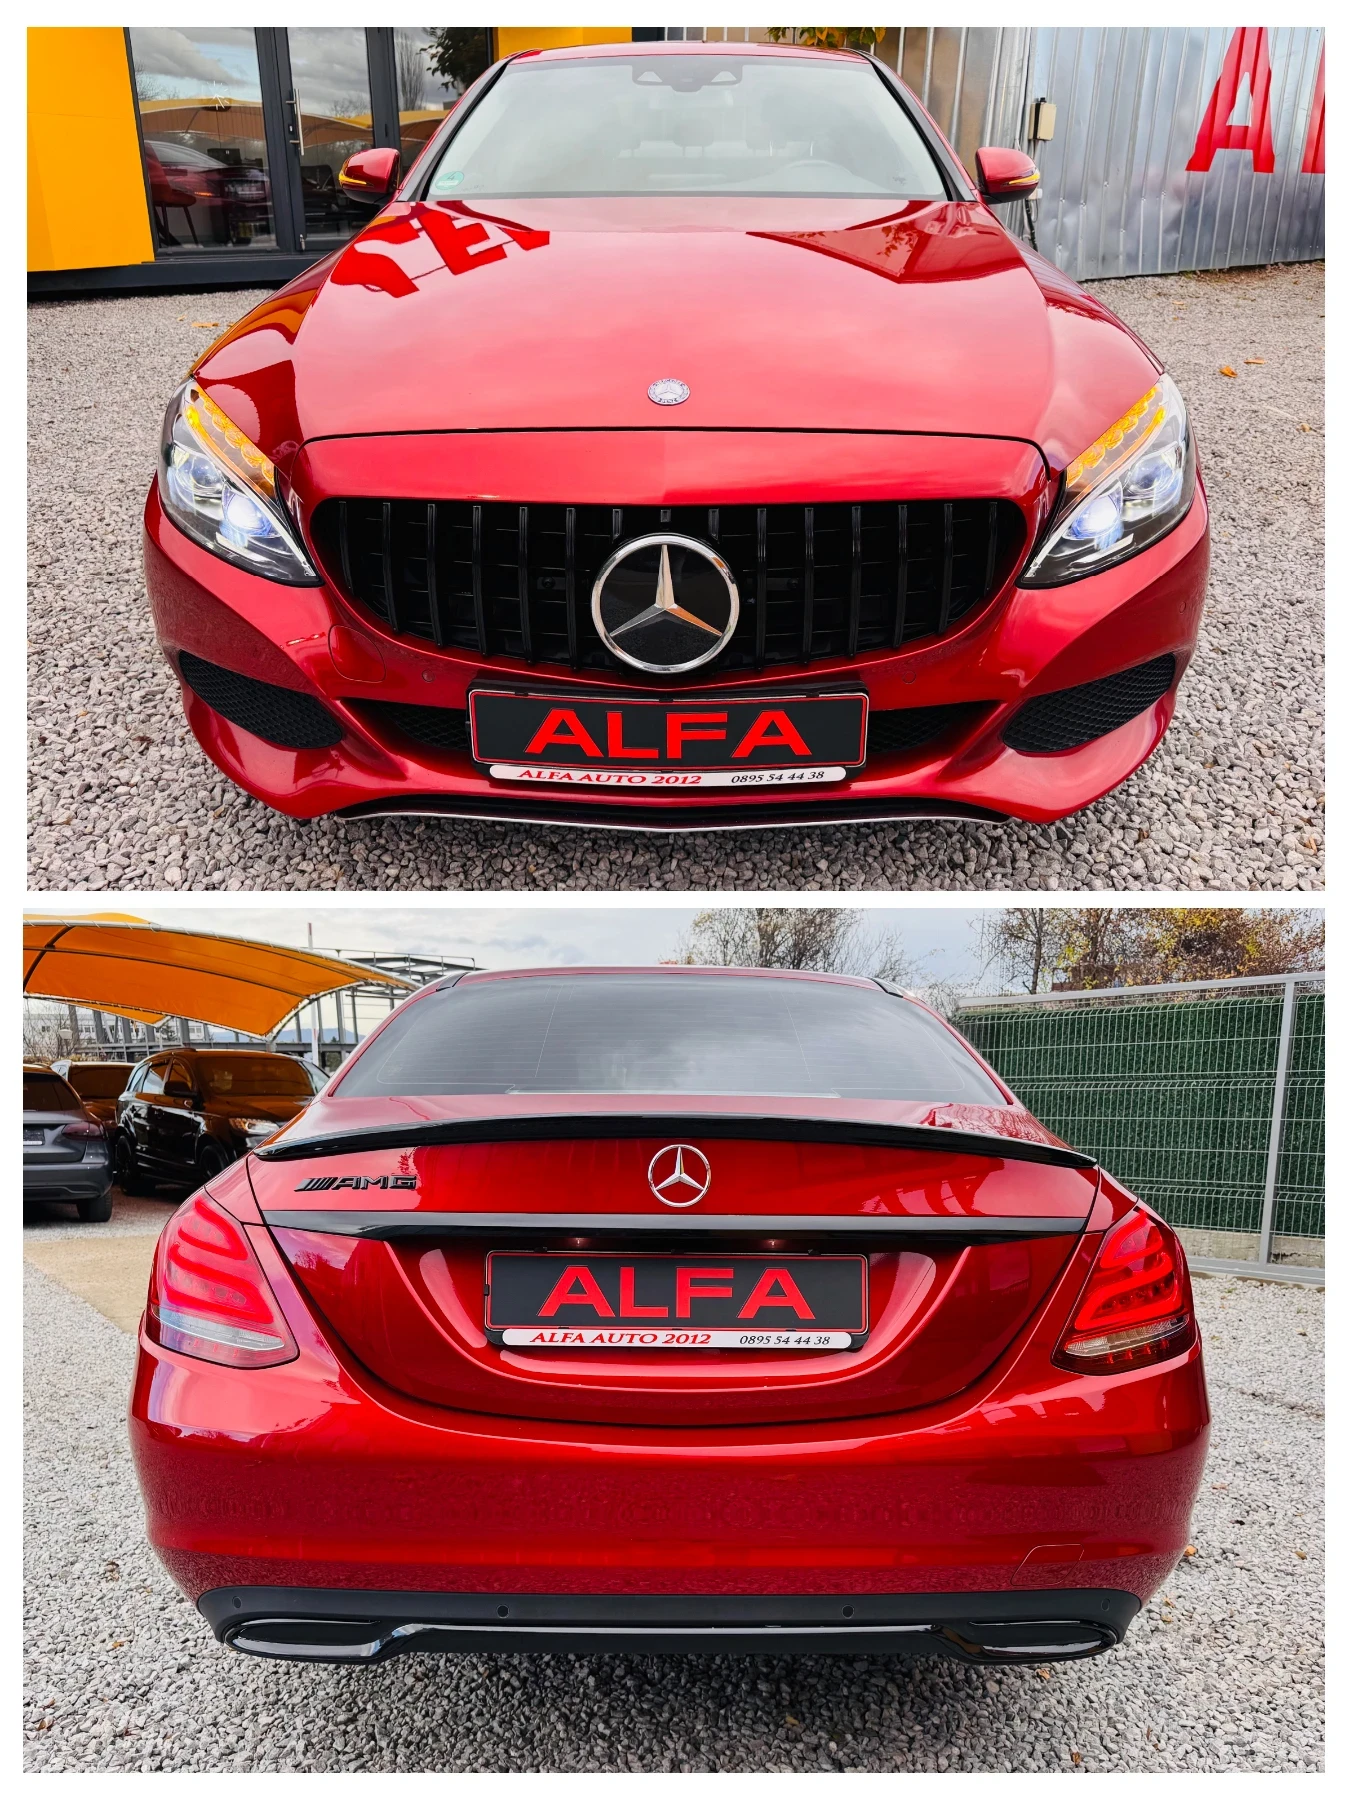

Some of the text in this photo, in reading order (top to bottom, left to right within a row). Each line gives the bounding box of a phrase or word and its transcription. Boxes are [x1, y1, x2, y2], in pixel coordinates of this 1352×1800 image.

[524, 707, 813, 760] ALFA
[517, 769, 825, 785] ALFA AUTO 2012 0895 54 44 38
[331, 1175, 417, 1190] AMG
[537, 1264, 816, 1320] ALFA
[529, 1332, 831, 1346] ALFA AUTO 2012 0895 54 44 38
